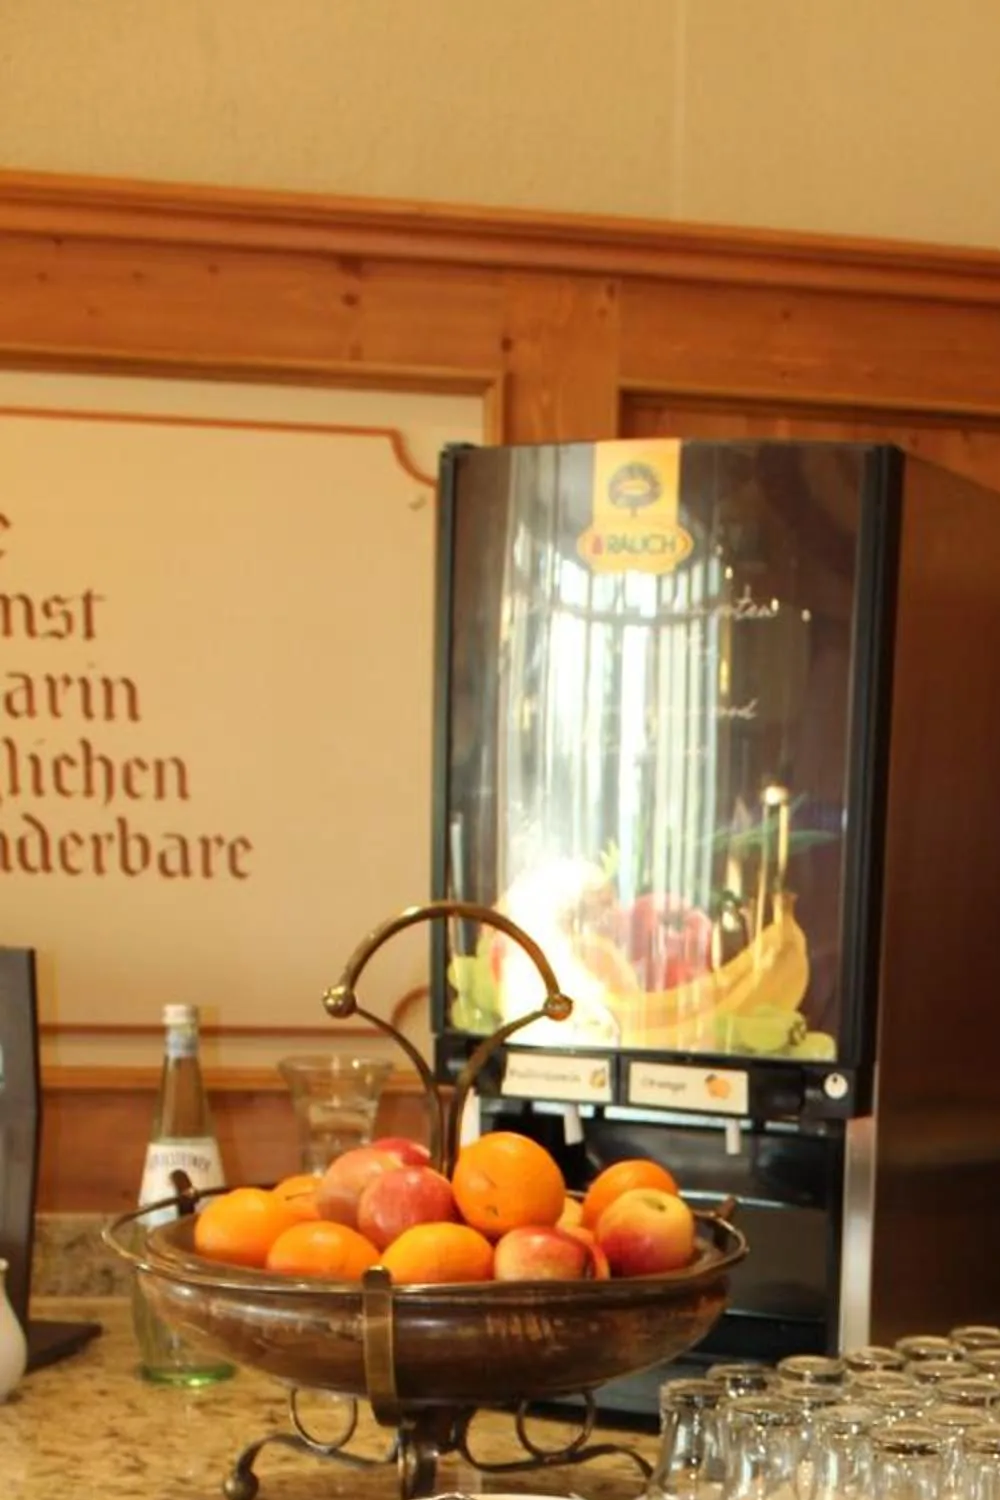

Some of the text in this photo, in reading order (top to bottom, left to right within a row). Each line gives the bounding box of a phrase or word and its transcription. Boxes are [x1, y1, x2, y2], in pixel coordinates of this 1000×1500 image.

[606, 533, 677, 556] RAUCH
[0, 588, 106, 641] nst
[4, 661, 141, 722] arin
[0, 735, 190, 808] lichen
